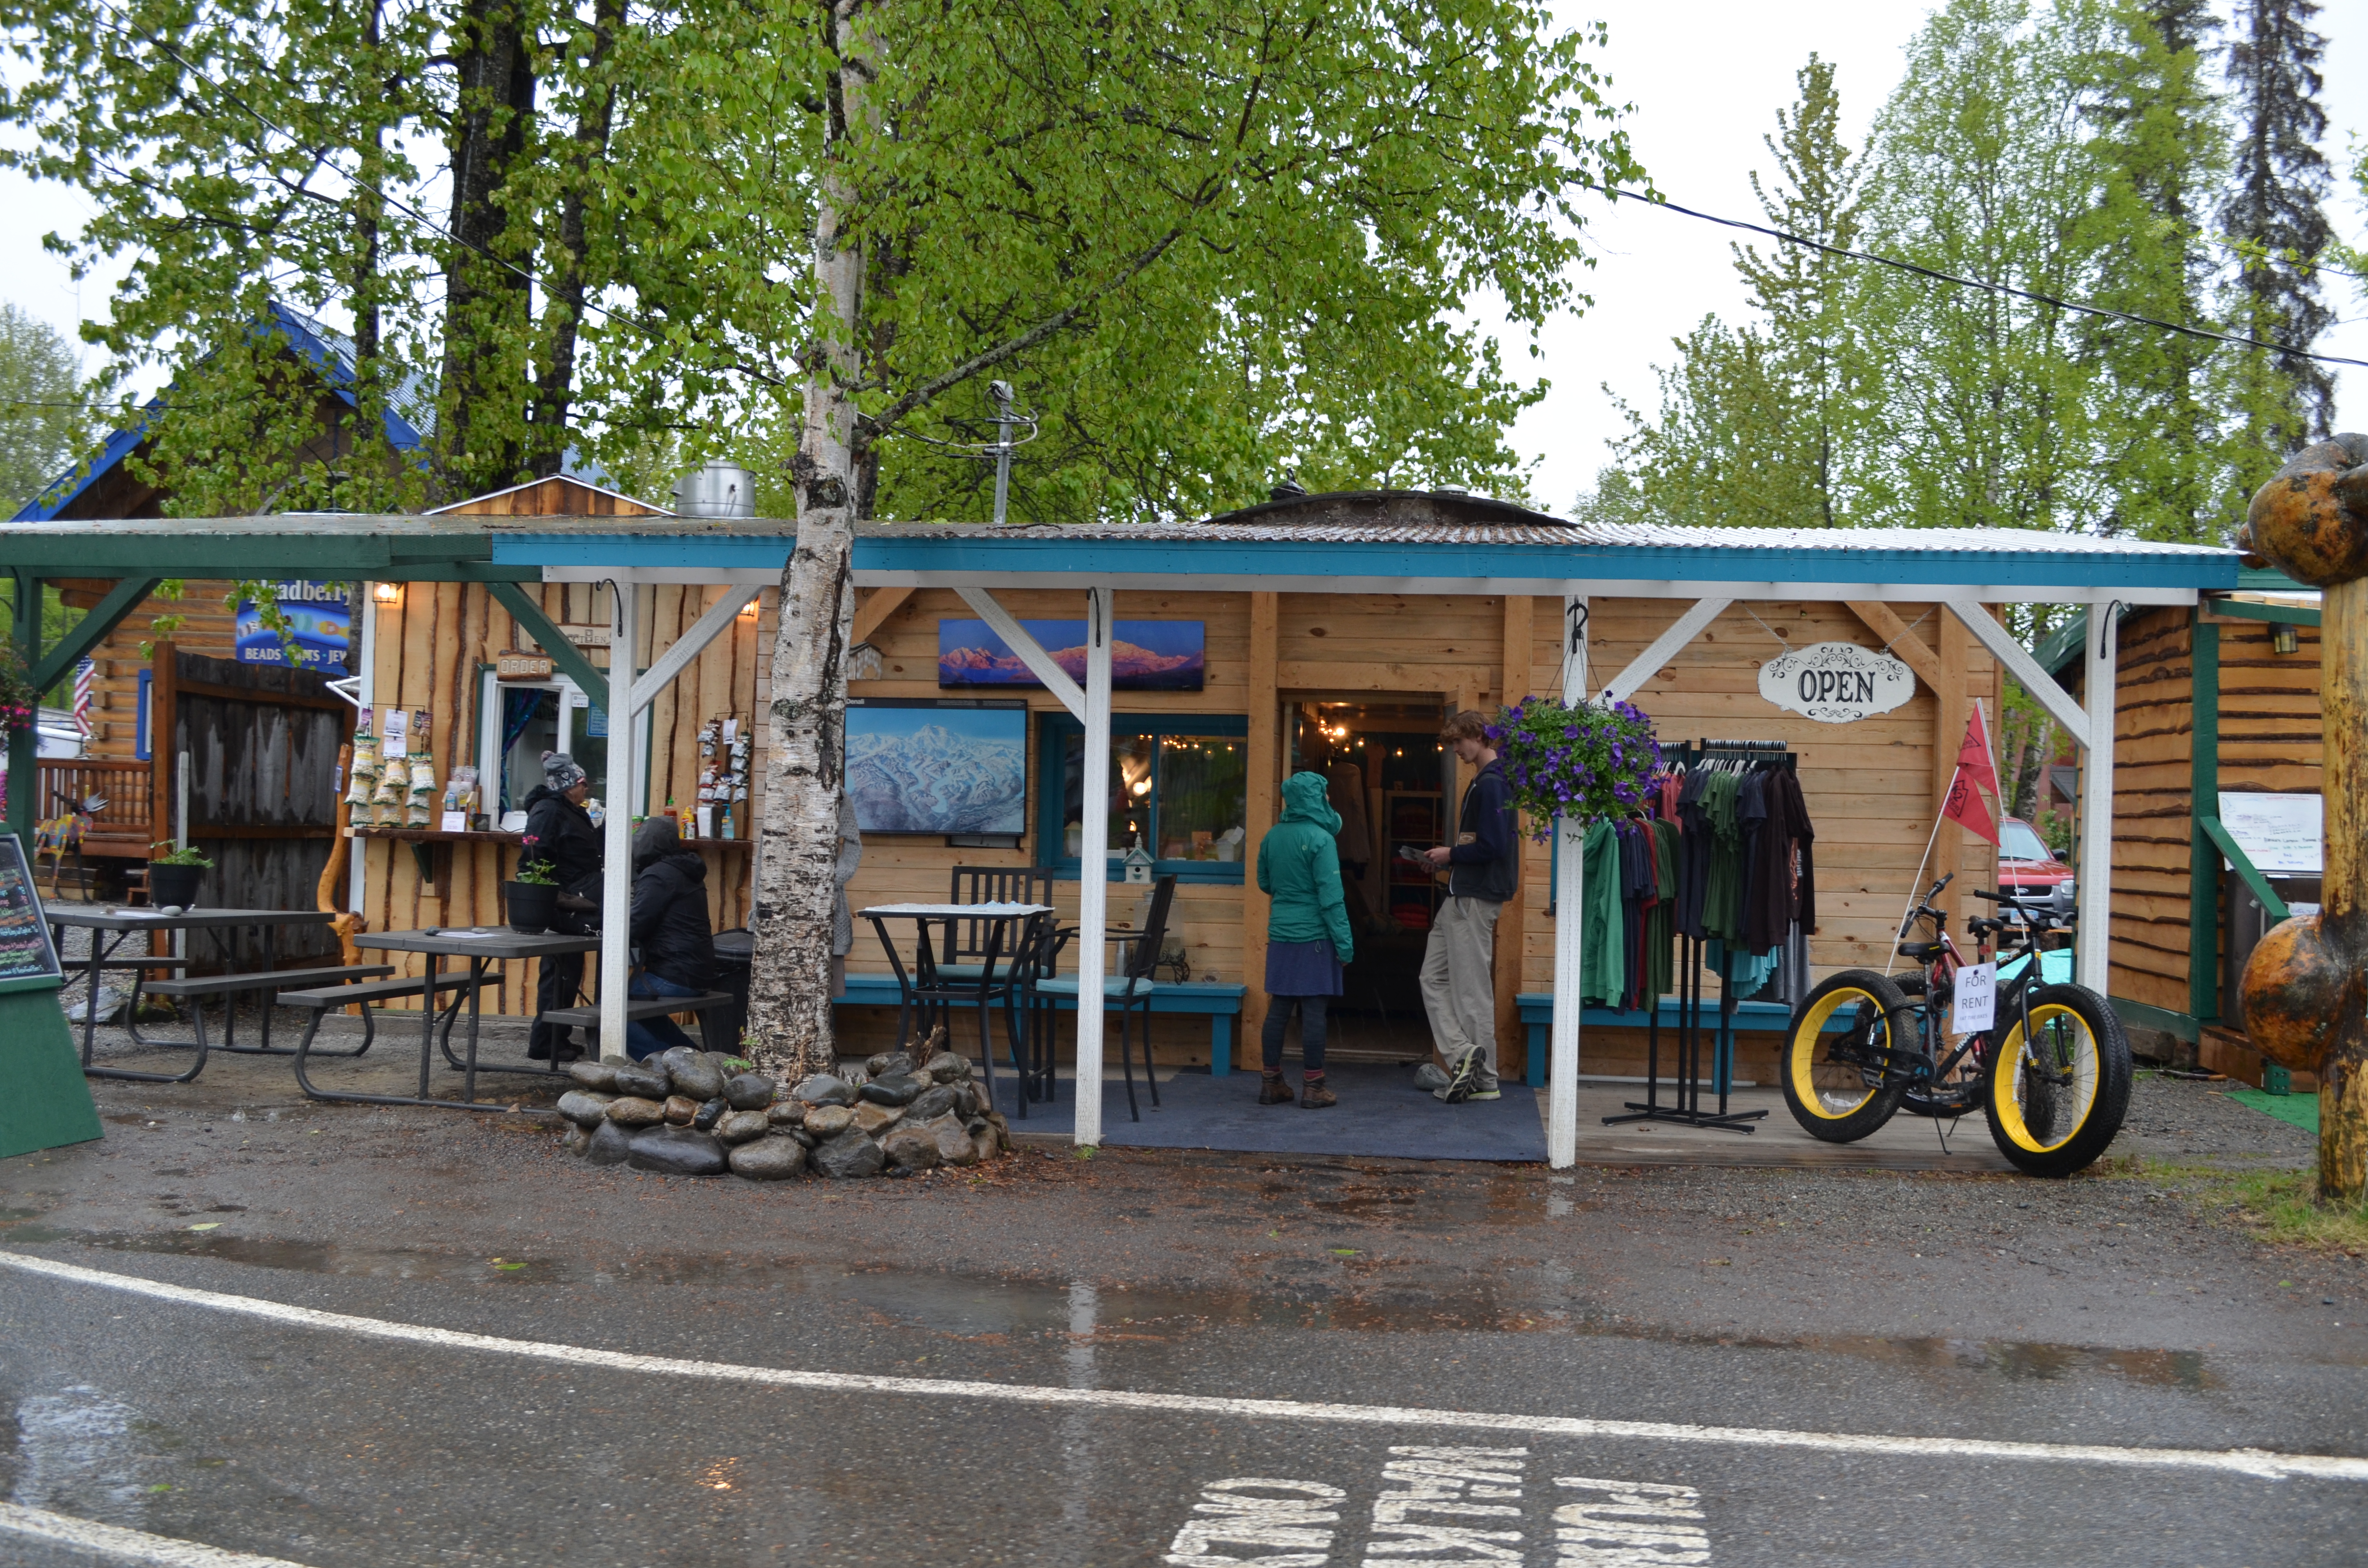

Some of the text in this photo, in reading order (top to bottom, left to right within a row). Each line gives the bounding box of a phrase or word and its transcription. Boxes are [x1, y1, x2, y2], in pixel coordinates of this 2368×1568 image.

[245, 648, 282, 661] BEADS
[501, 659, 547, 674] ORDER
[1798, 670, 1875, 703] OPEN
[1965, 975, 1986, 988] FOR
[1961, 995, 1988, 1009] RENT
